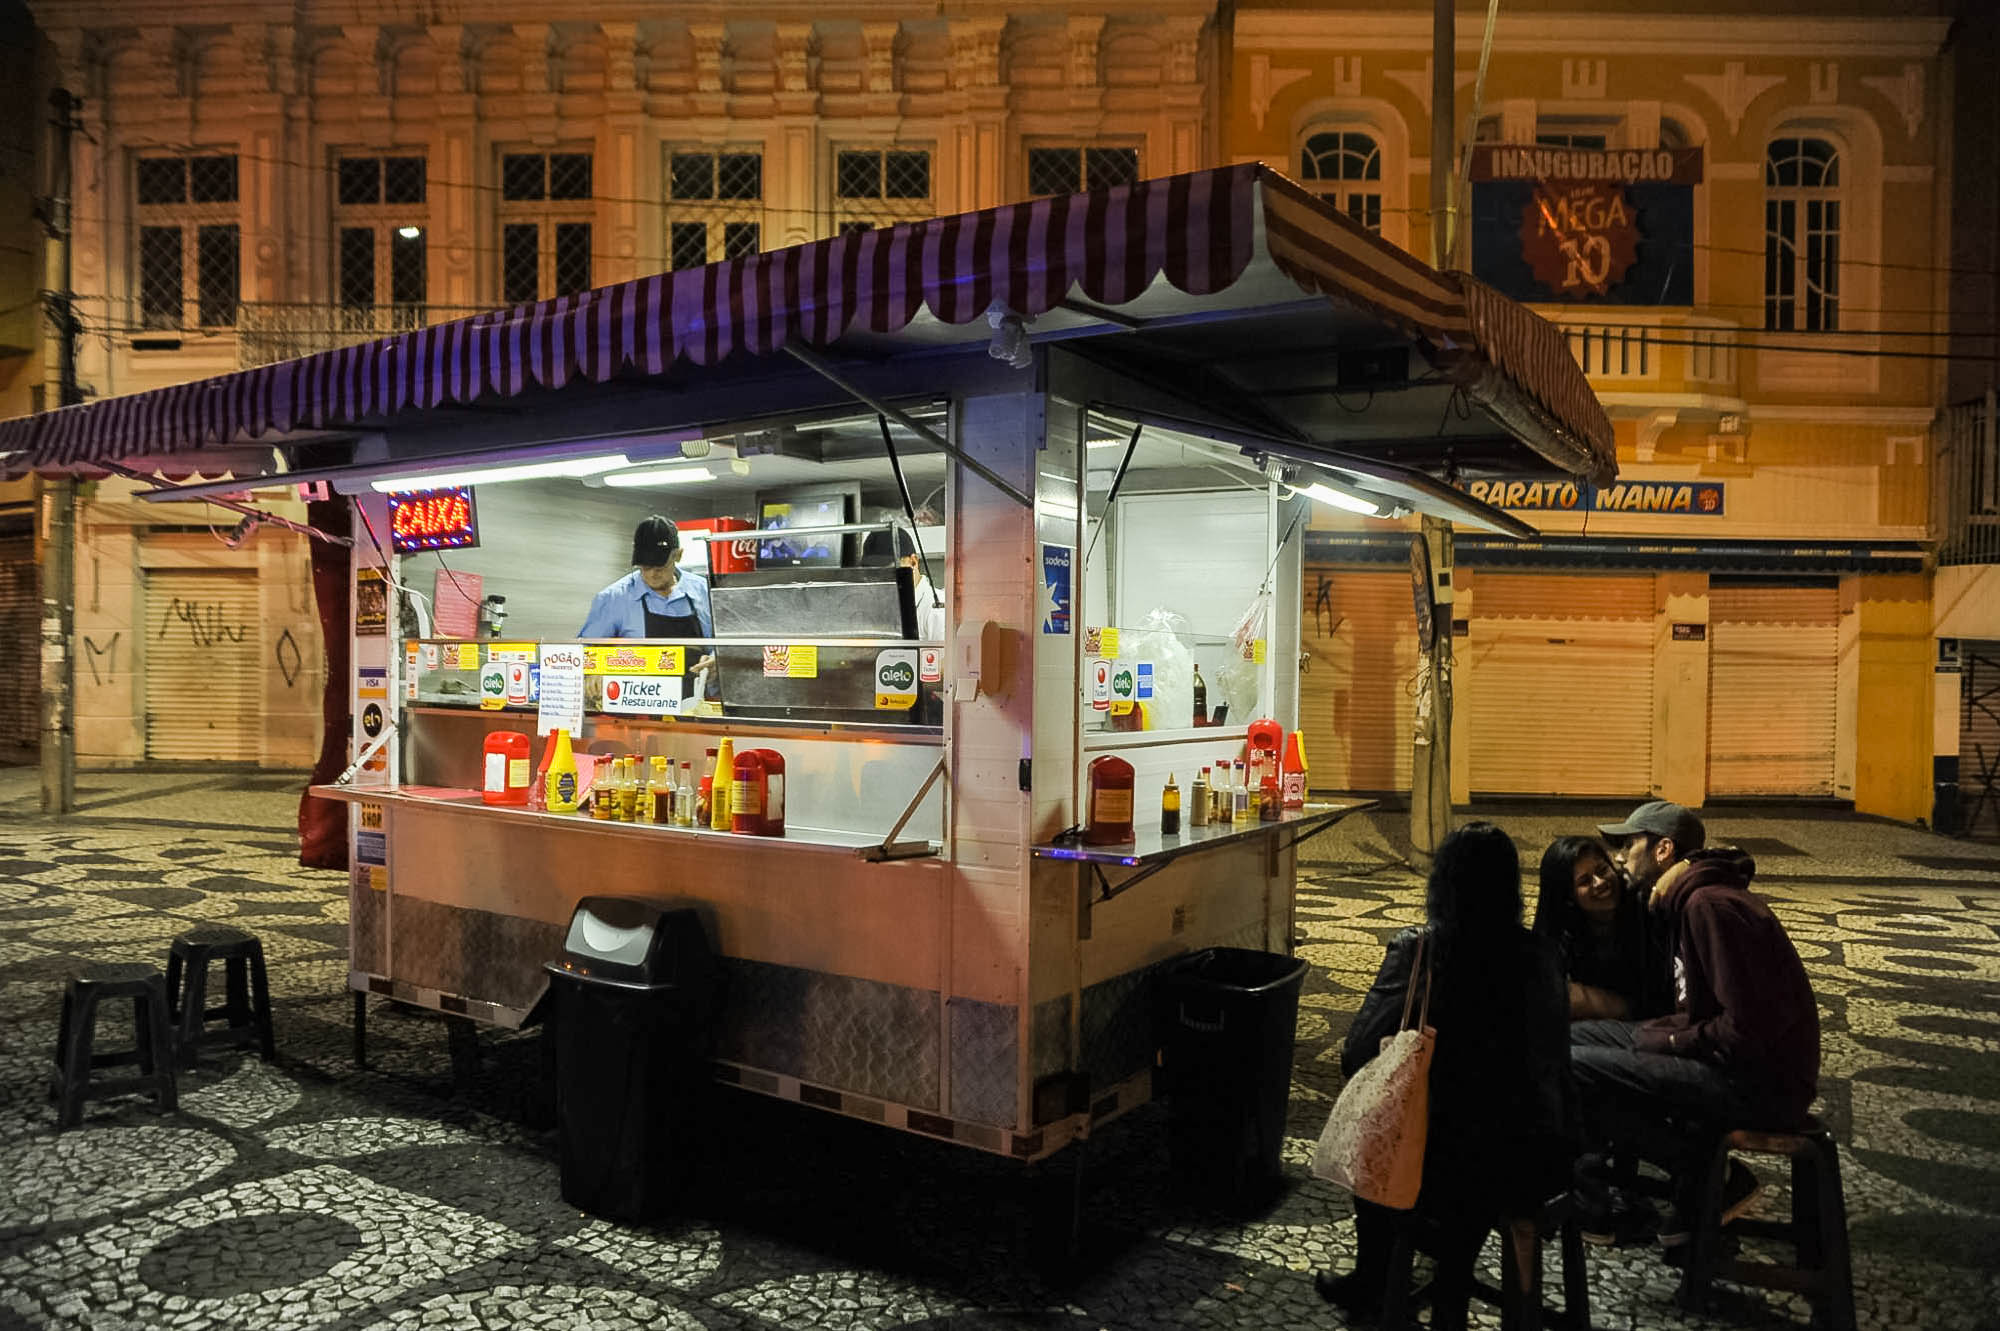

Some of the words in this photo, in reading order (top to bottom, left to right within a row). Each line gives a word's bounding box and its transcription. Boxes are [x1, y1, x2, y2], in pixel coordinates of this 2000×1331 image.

[1537, 194, 1627, 237] MEGA
[1559, 236, 1612, 288] 10
[1470, 480, 1579, 509] BARATO
[1595, 484, 1693, 511] MANIA
[393, 496, 468, 536] CAIXA
[544, 652, 581, 667] DOGÃO
[882, 670, 912, 681] alelo
[622, 681, 661, 695] Ticket
[622, 697, 678, 708] Restaurante
